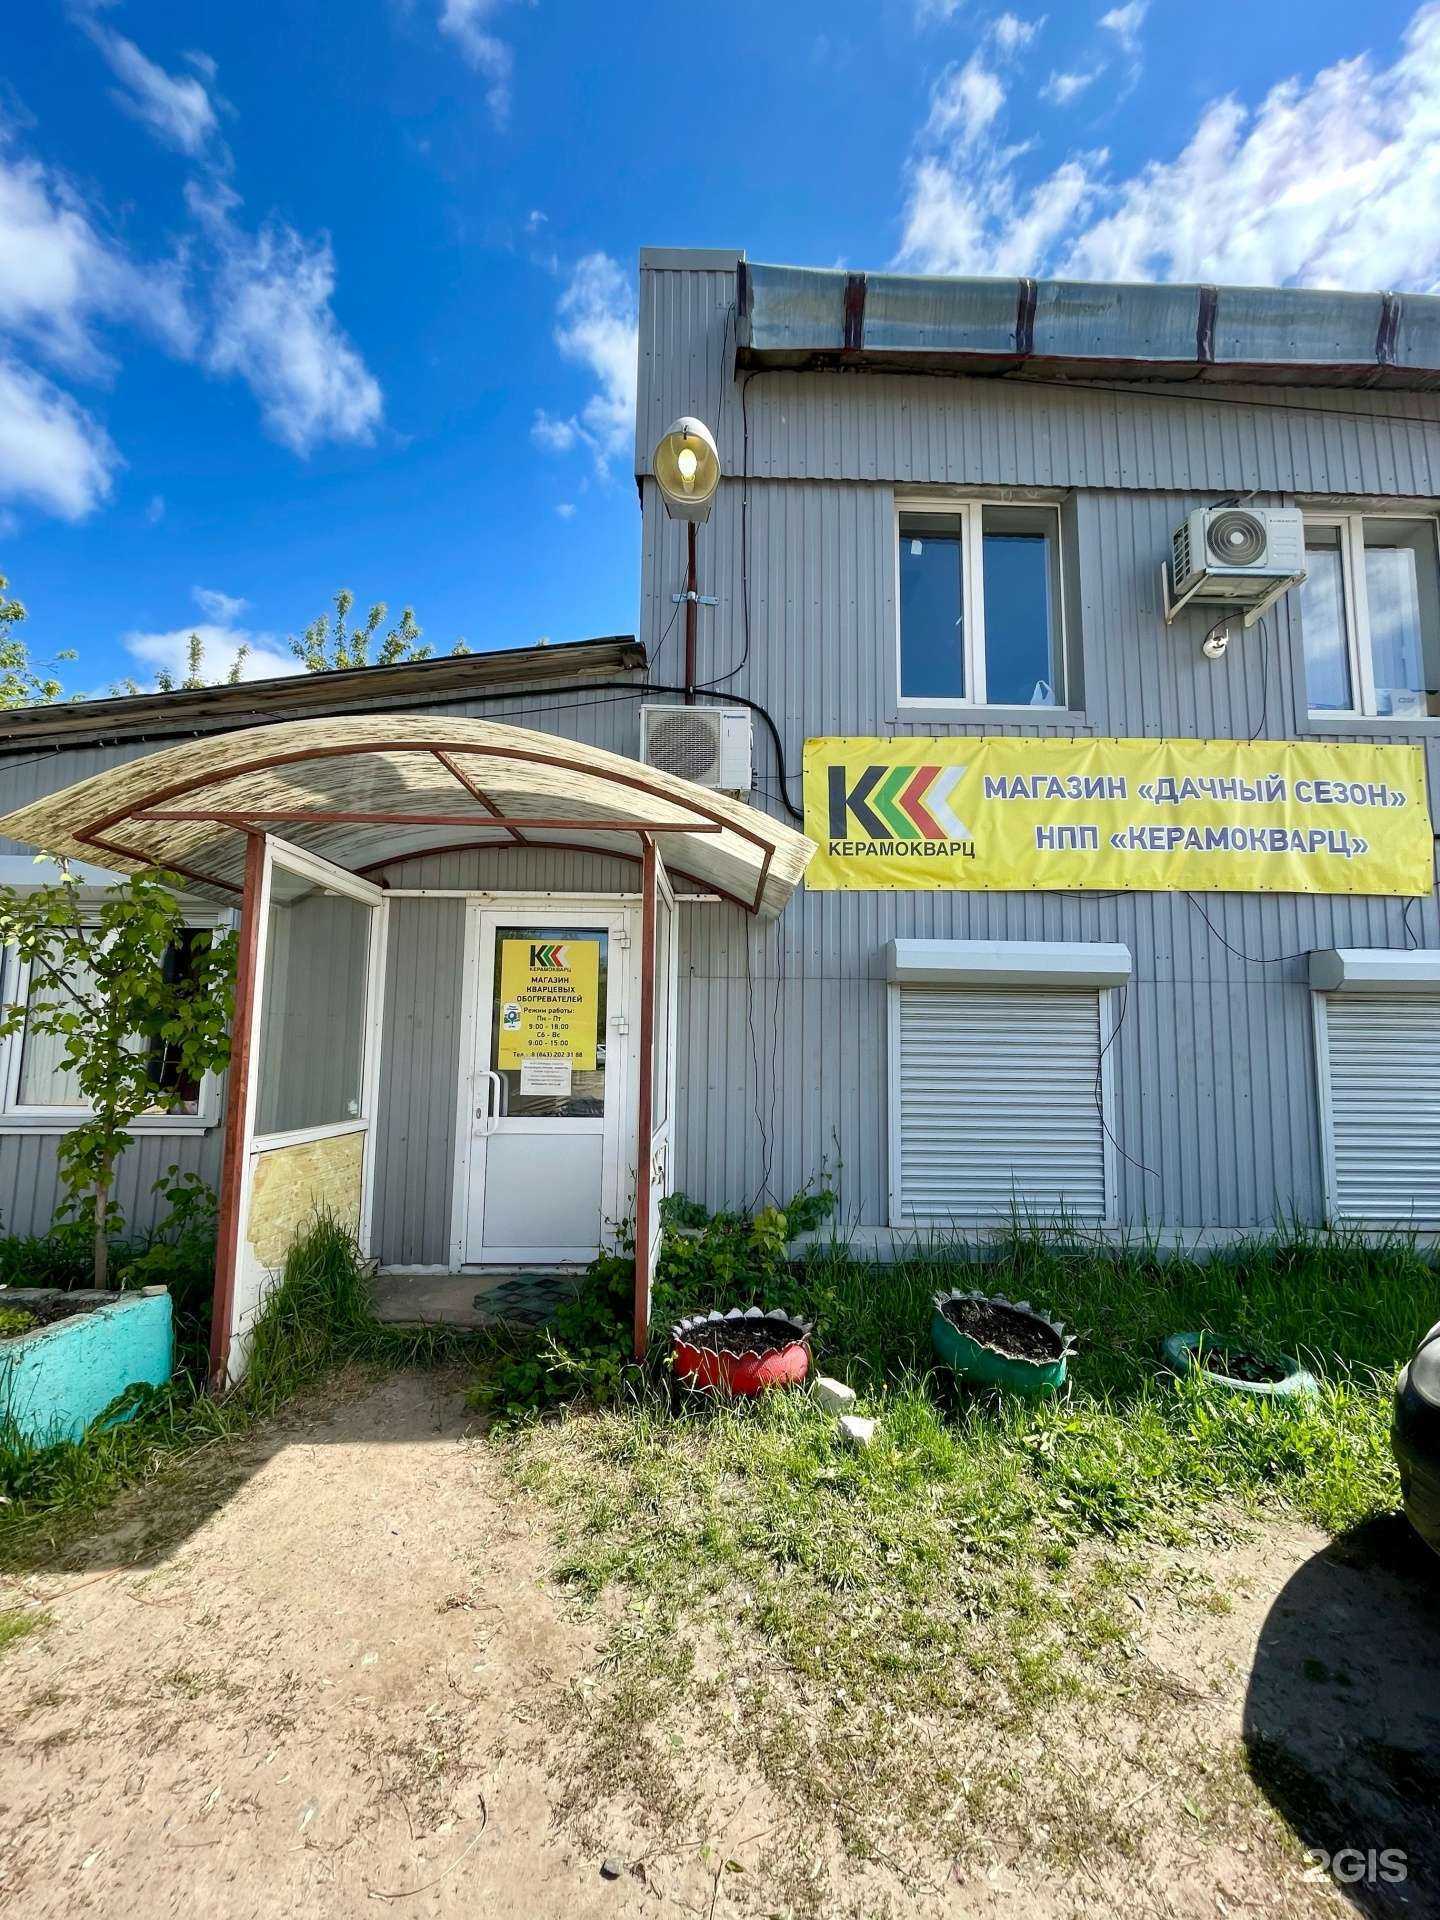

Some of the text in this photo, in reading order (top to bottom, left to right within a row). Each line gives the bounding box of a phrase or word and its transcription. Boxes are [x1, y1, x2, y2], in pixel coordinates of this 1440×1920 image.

[984, 774, 1407, 806] МАГАЗИН «ДАЧНЫЙ СЕЗОН»
[828, 842, 976, 859] КЕРАМОКВАРЦ
[1035, 825, 1369, 857] НПП «КЕРАМОКВАРЦ»
[516, 995, 583, 1003] ОБОГРЕВАТЕЛЕЙ
